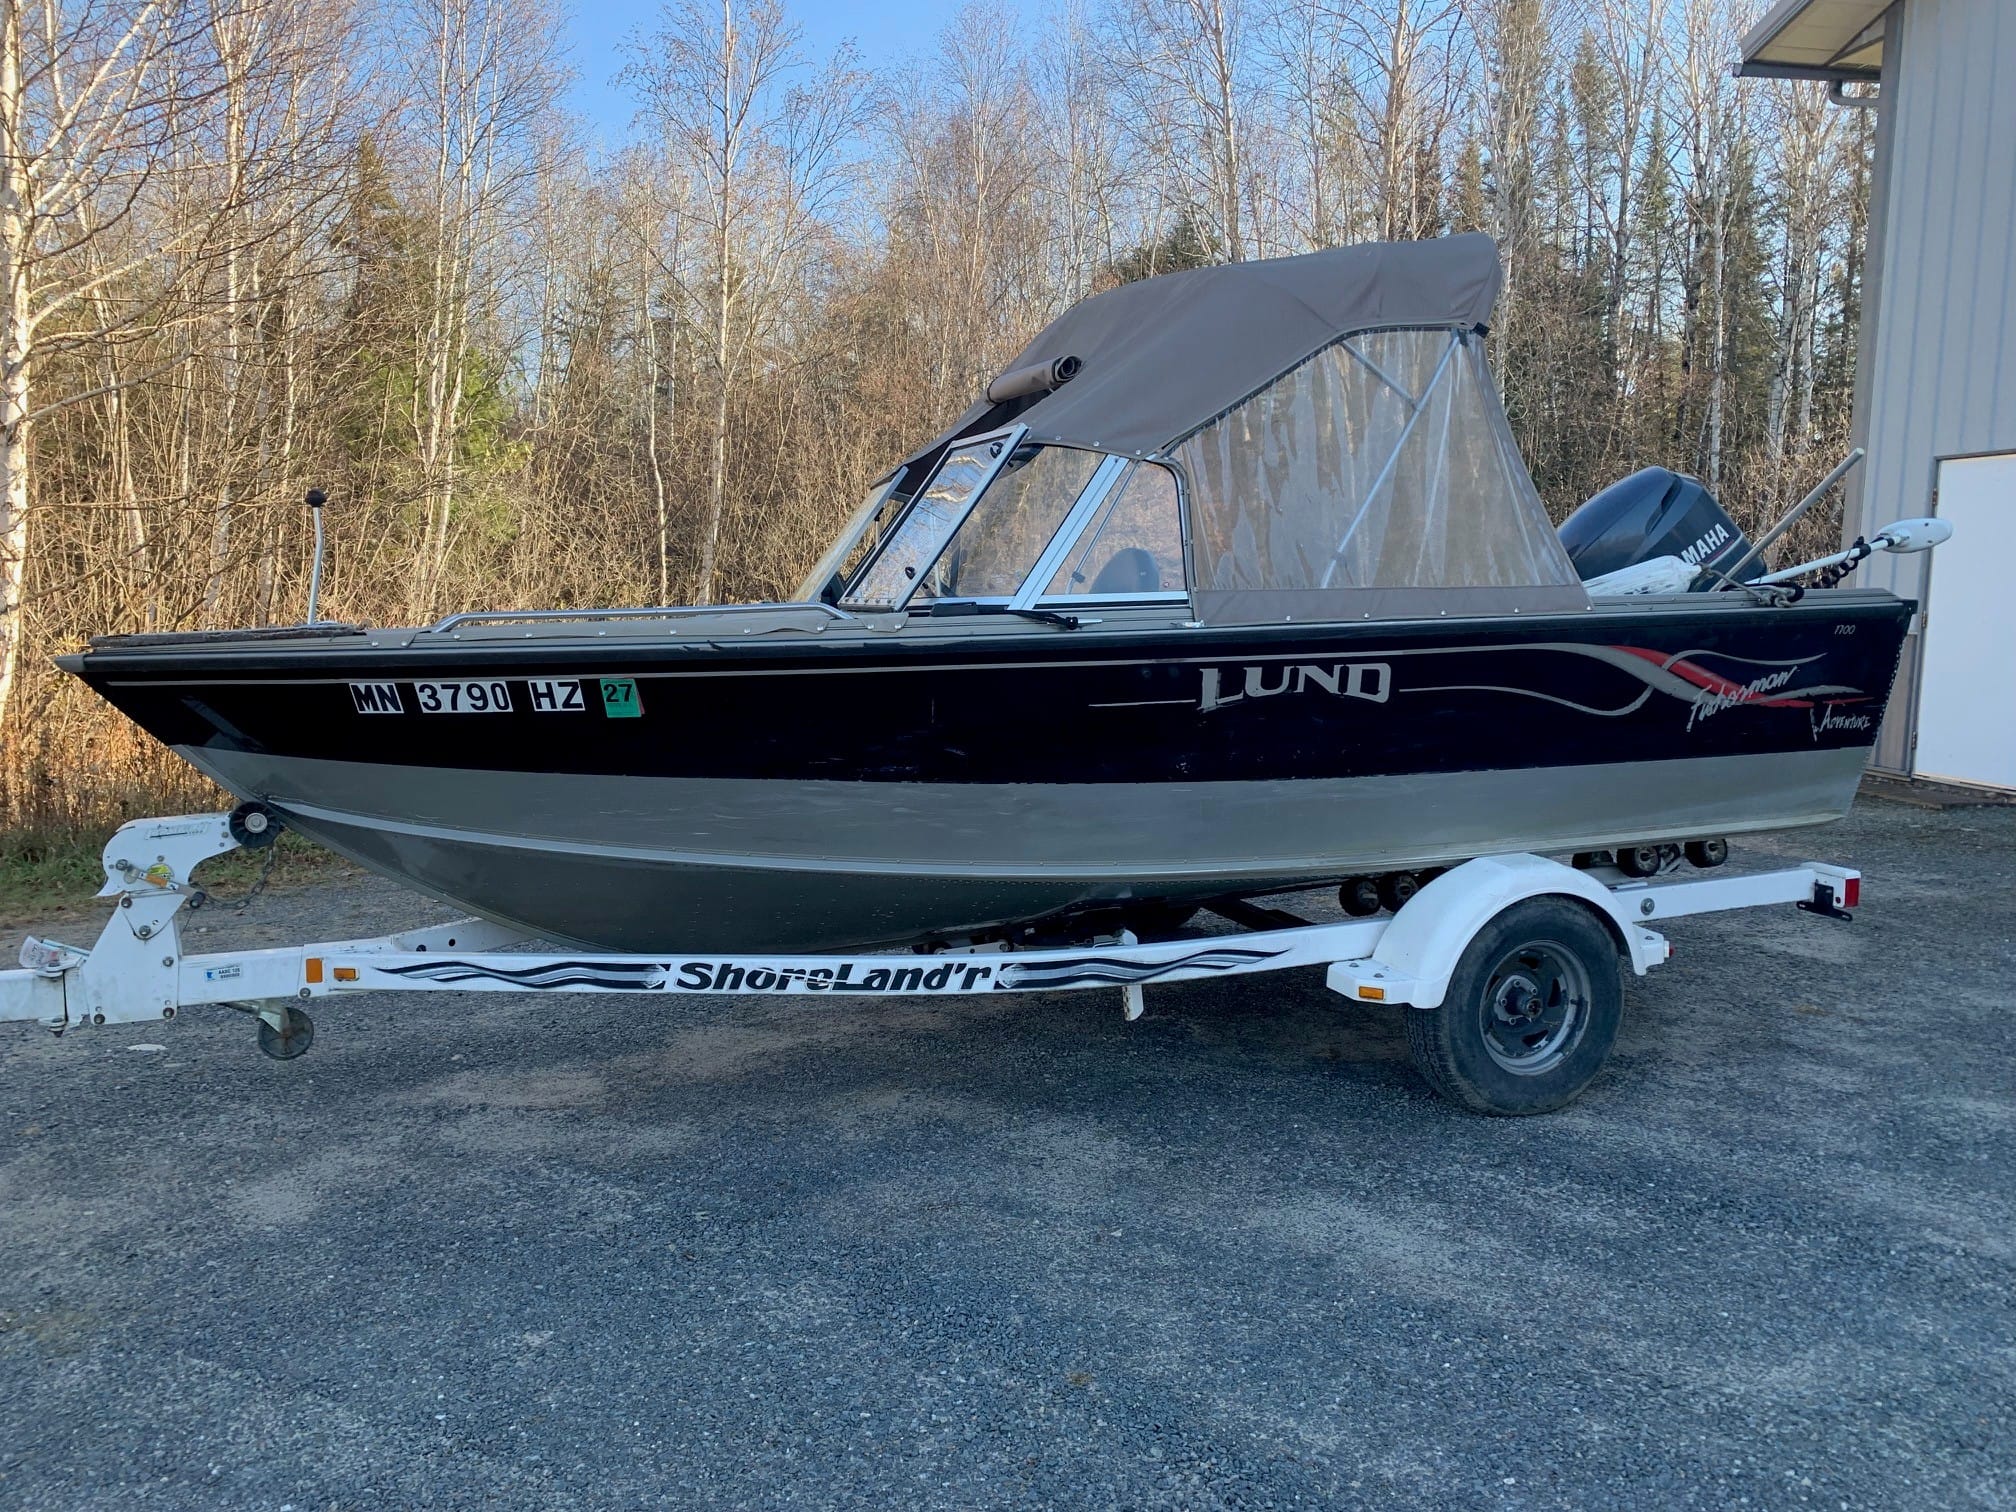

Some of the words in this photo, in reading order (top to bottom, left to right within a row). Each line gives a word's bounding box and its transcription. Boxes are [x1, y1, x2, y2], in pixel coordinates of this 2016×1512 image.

[1680, 523, 1730, 566] MAHA
[1834, 624, 1856, 635] 1700
[352, 683, 402, 712] MN
[417, 682, 512, 711] 3790
[530, 680, 584, 710] HZ
[603, 683, 633, 703] 27
[1197, 662, 1392, 712] LUND
[675, 961, 992, 992] ShoreLand'r
